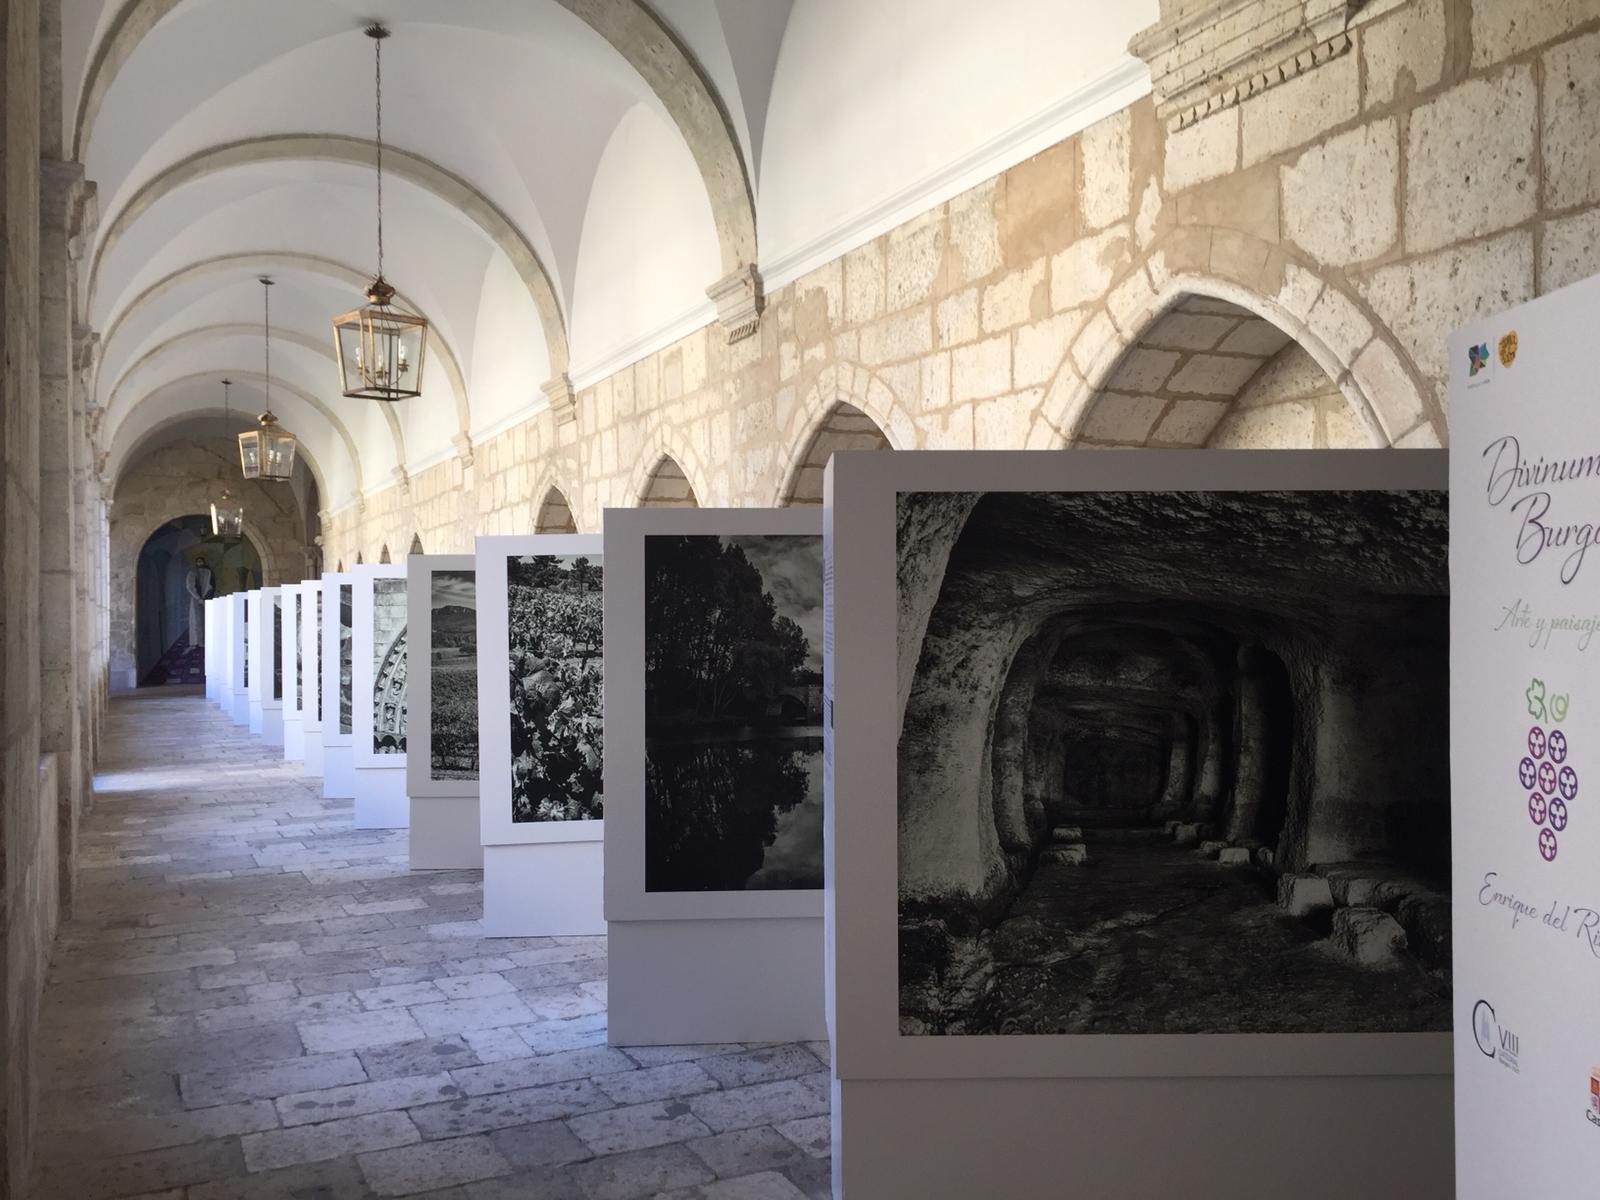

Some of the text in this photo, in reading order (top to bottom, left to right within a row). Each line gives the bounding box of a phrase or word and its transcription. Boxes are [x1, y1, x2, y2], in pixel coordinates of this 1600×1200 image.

[1528, 618, 1545, 648] y
[1479, 872, 1600, 959] Enrique del Ri
[1497, 1024, 1519, 1055] VIII
